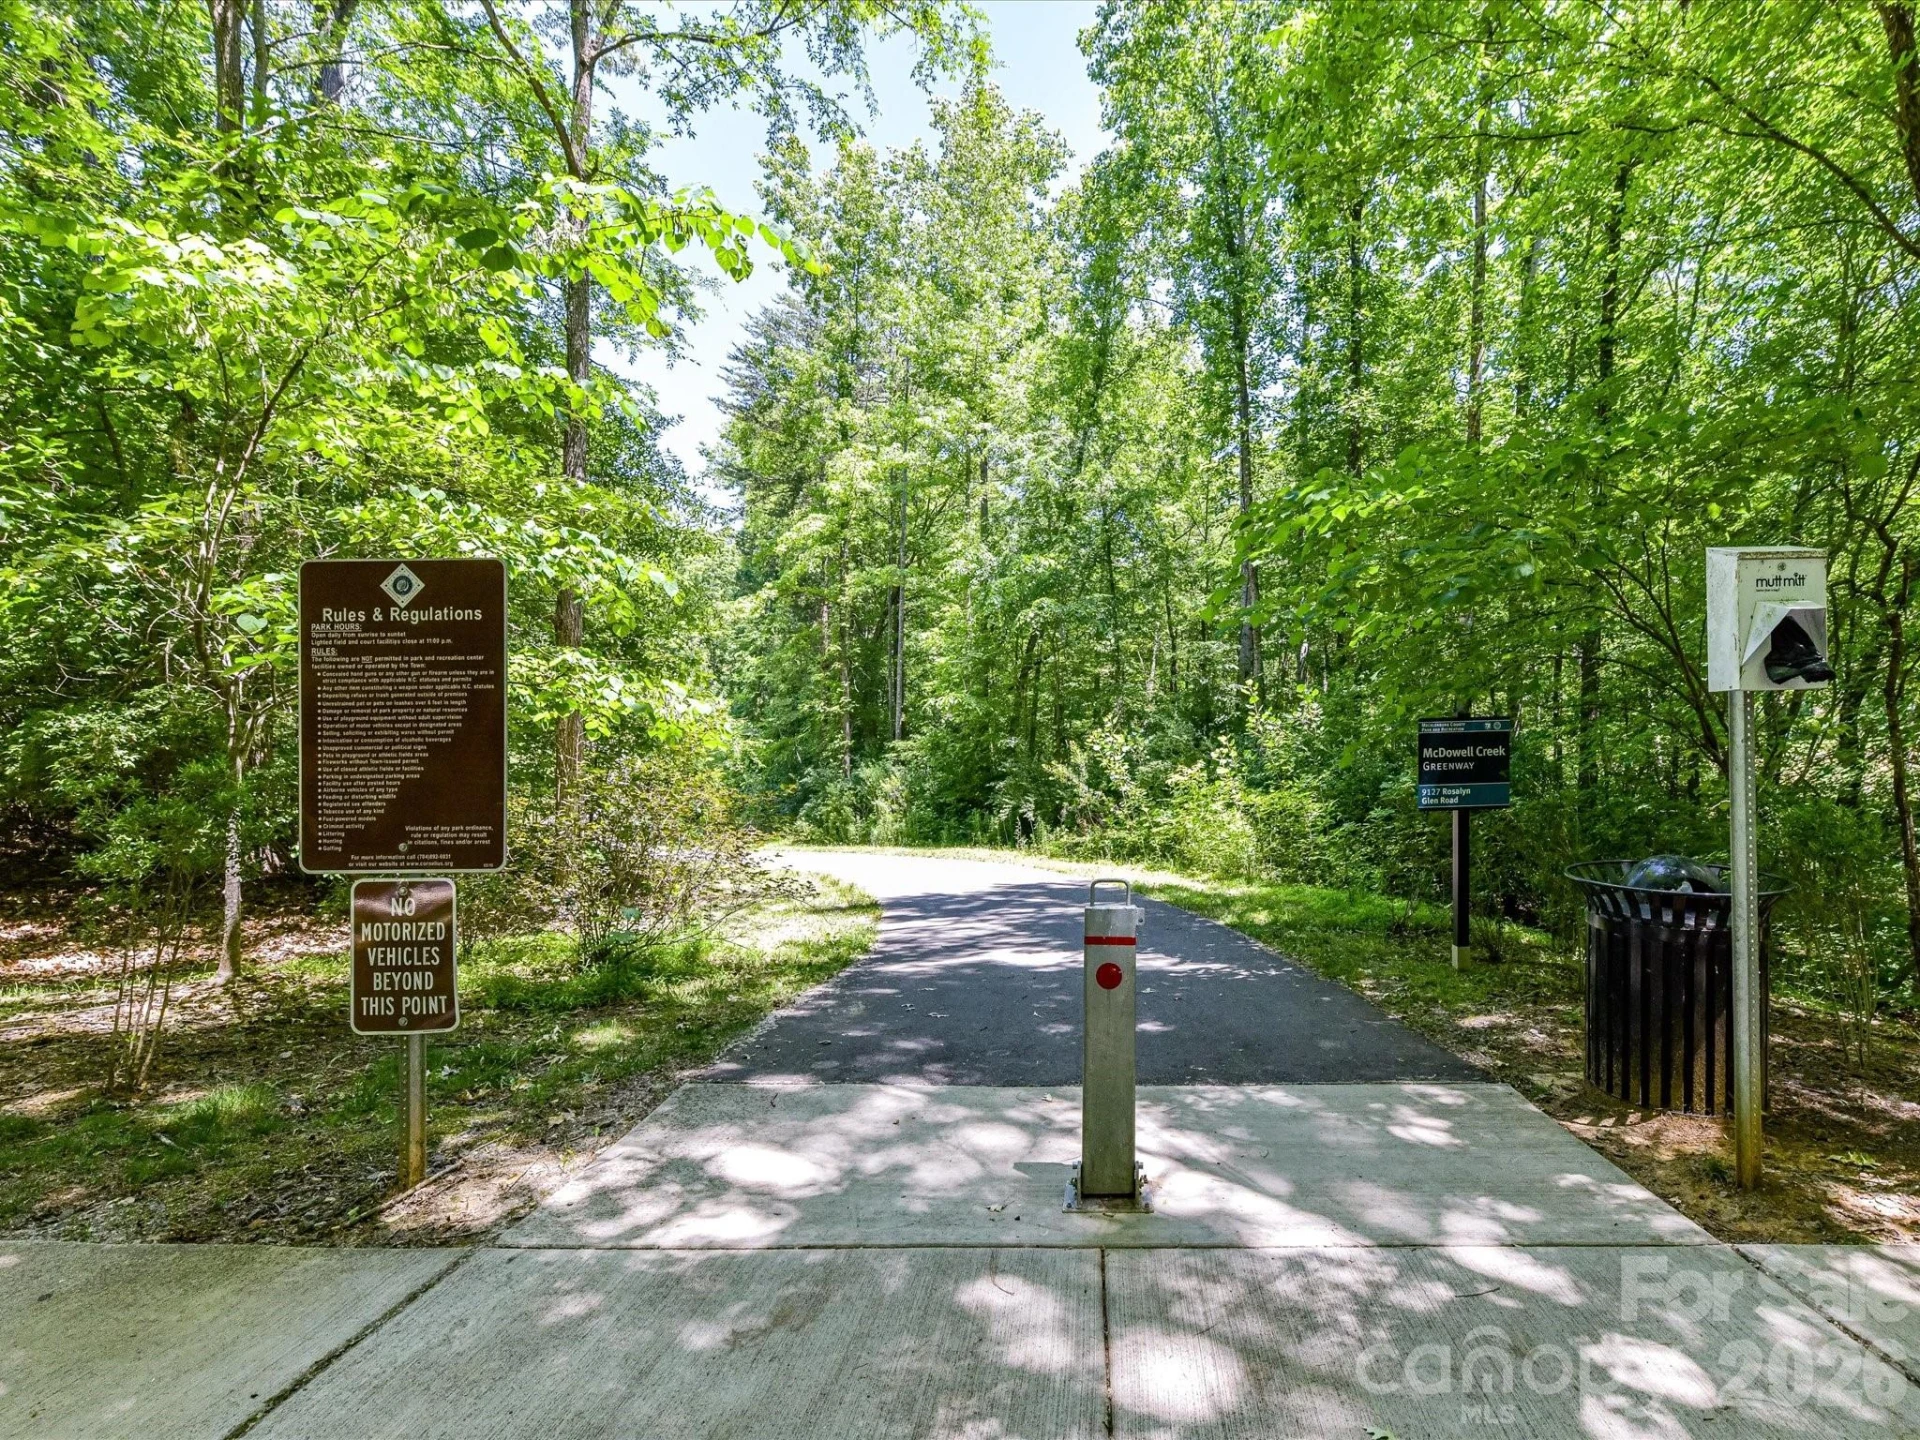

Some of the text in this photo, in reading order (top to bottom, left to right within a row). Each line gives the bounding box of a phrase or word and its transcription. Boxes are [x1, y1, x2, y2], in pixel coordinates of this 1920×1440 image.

[1756, 573, 1805, 587] mutt mitt
[322, 606, 482, 624] Rules & Regulations
[1423, 746, 1506, 758] McDowell Creek
[1423, 762, 1475, 771] GREENWAY
[1442, 788, 1470, 796] Rosalyn
[391, 898, 416, 916] NO
[361, 922, 445, 942] MOTORIZED
[368, 947, 440, 966] VEHICLES
[373, 972, 433, 991] BEYOND
[361, 996, 447, 1015] THIS POINT
